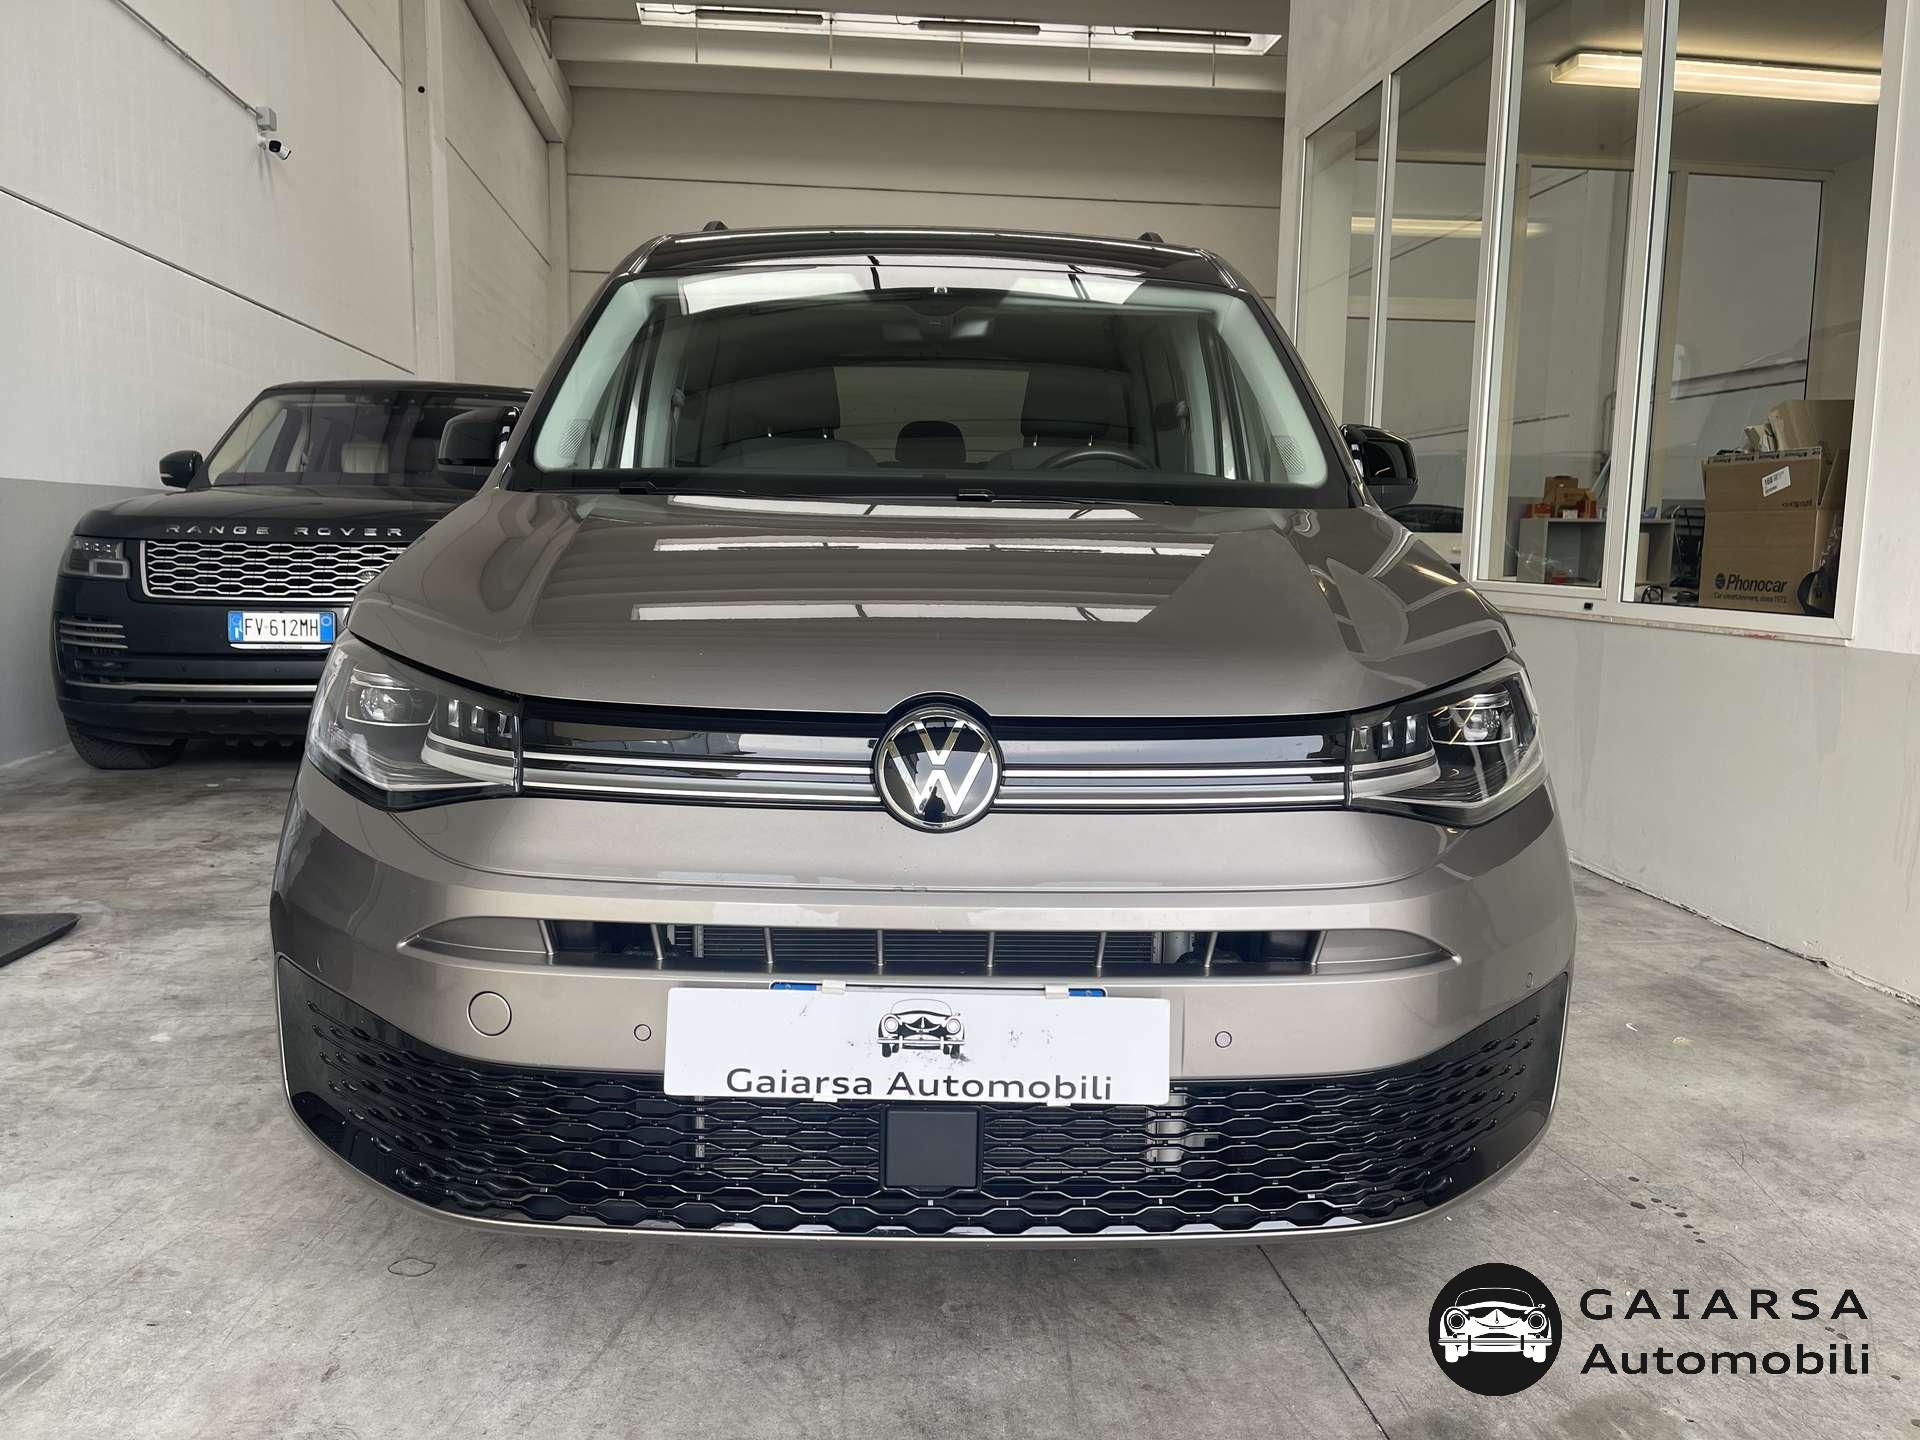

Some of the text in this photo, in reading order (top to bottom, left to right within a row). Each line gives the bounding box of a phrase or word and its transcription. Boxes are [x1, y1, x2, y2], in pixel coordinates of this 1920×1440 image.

[166, 525, 402, 537] RANGE ROVER
[1726, 573, 1788, 593] Phonocar
[726, 1068, 1112, 1101] Gaiarsa Automobili
